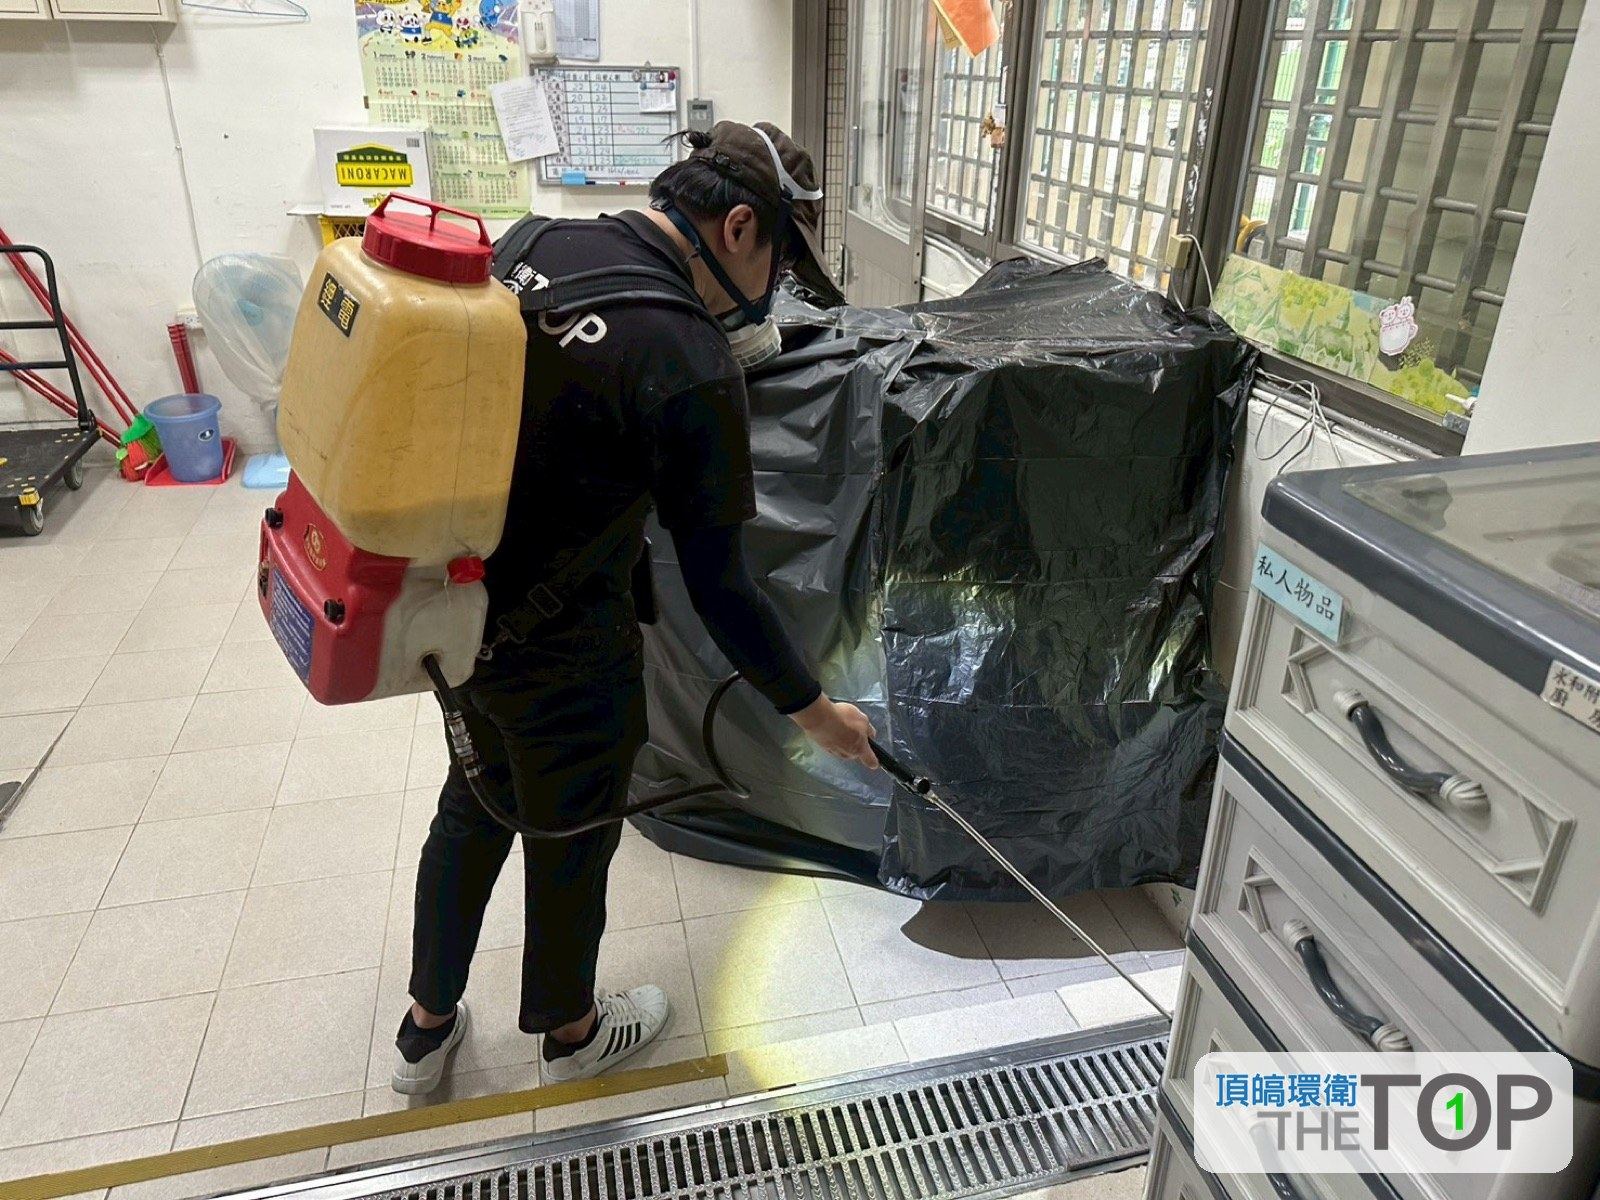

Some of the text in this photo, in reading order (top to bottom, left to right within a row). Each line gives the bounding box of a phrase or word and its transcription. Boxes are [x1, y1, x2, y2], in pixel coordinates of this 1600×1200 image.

[342, 167, 406, 180] MACARONI
[1257, 555, 1334, 620] 私人物品
